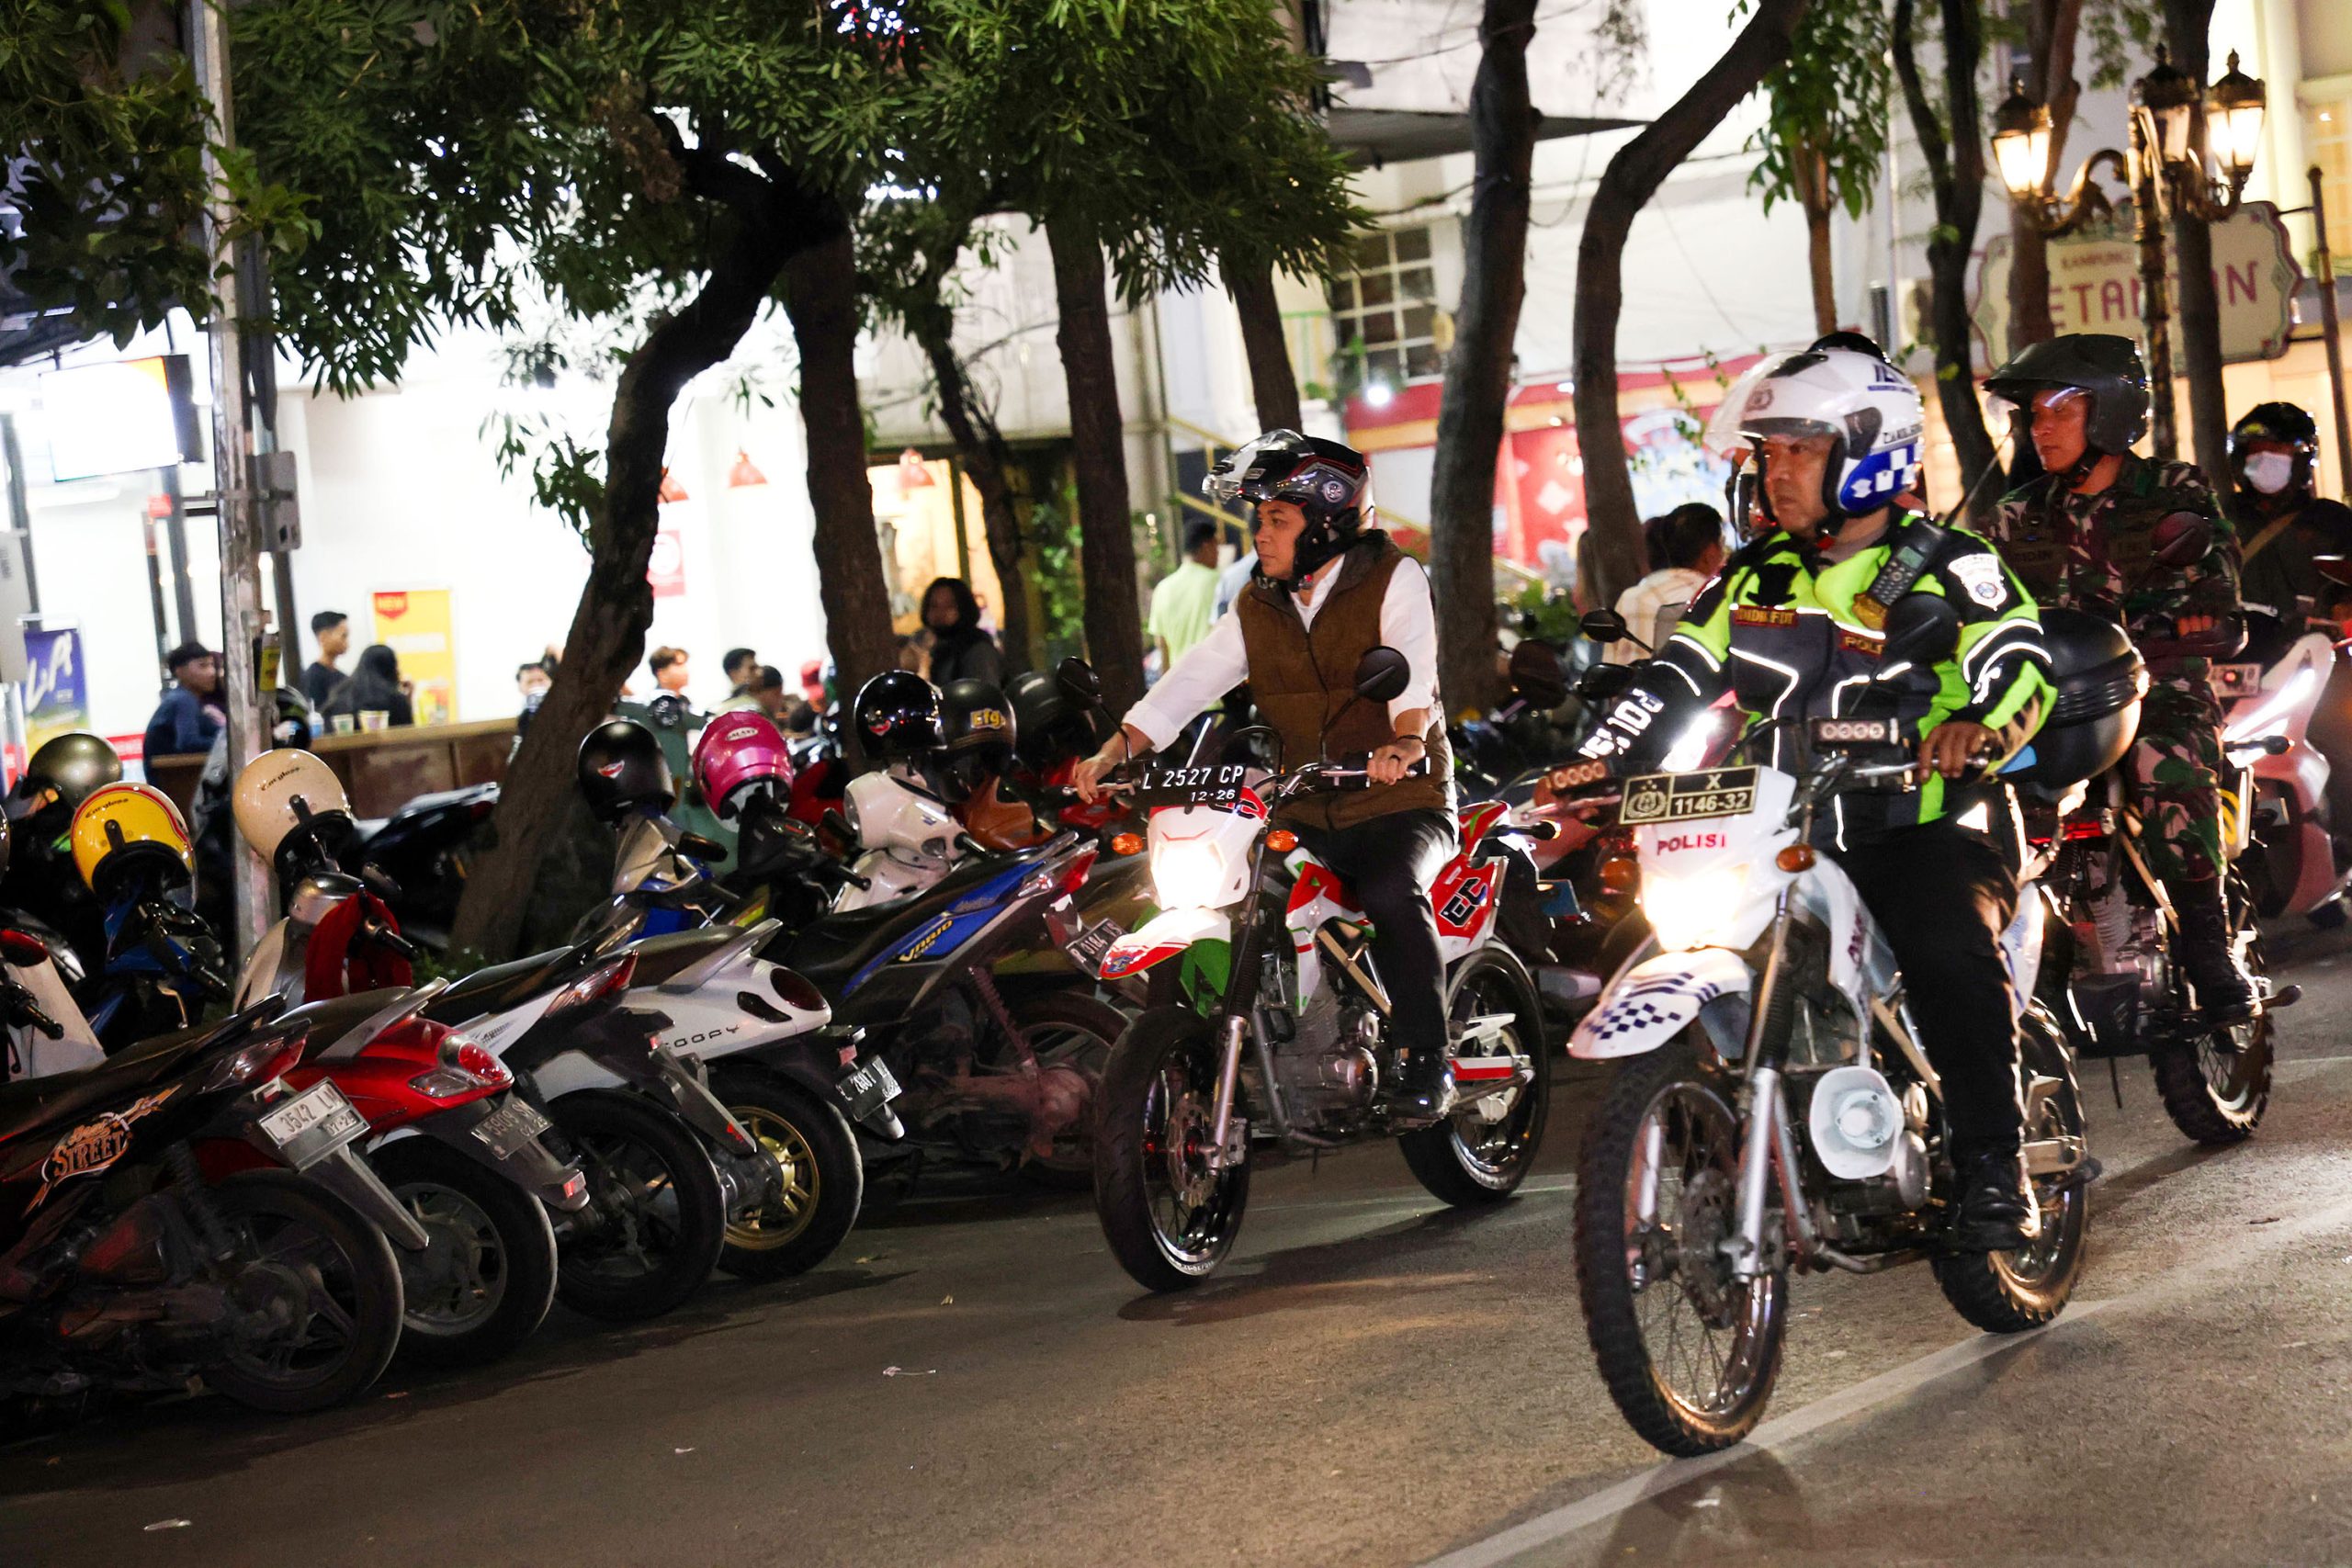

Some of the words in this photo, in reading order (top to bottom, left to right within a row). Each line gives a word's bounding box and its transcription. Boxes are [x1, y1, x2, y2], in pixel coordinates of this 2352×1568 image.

[1142, 773, 1152, 790] L
[1162, 767, 1212, 787] 2527
[1219, 765, 1244, 784] CP
[1705, 773, 1723, 790] X
[1675, 792, 1747, 815] 1146-32
[1657, 824, 1726, 855] POLISI
[899, 919, 953, 962] VARIO
[280, 1103, 316, 1133] 3542
[52, 1131, 124, 1178] STREET
